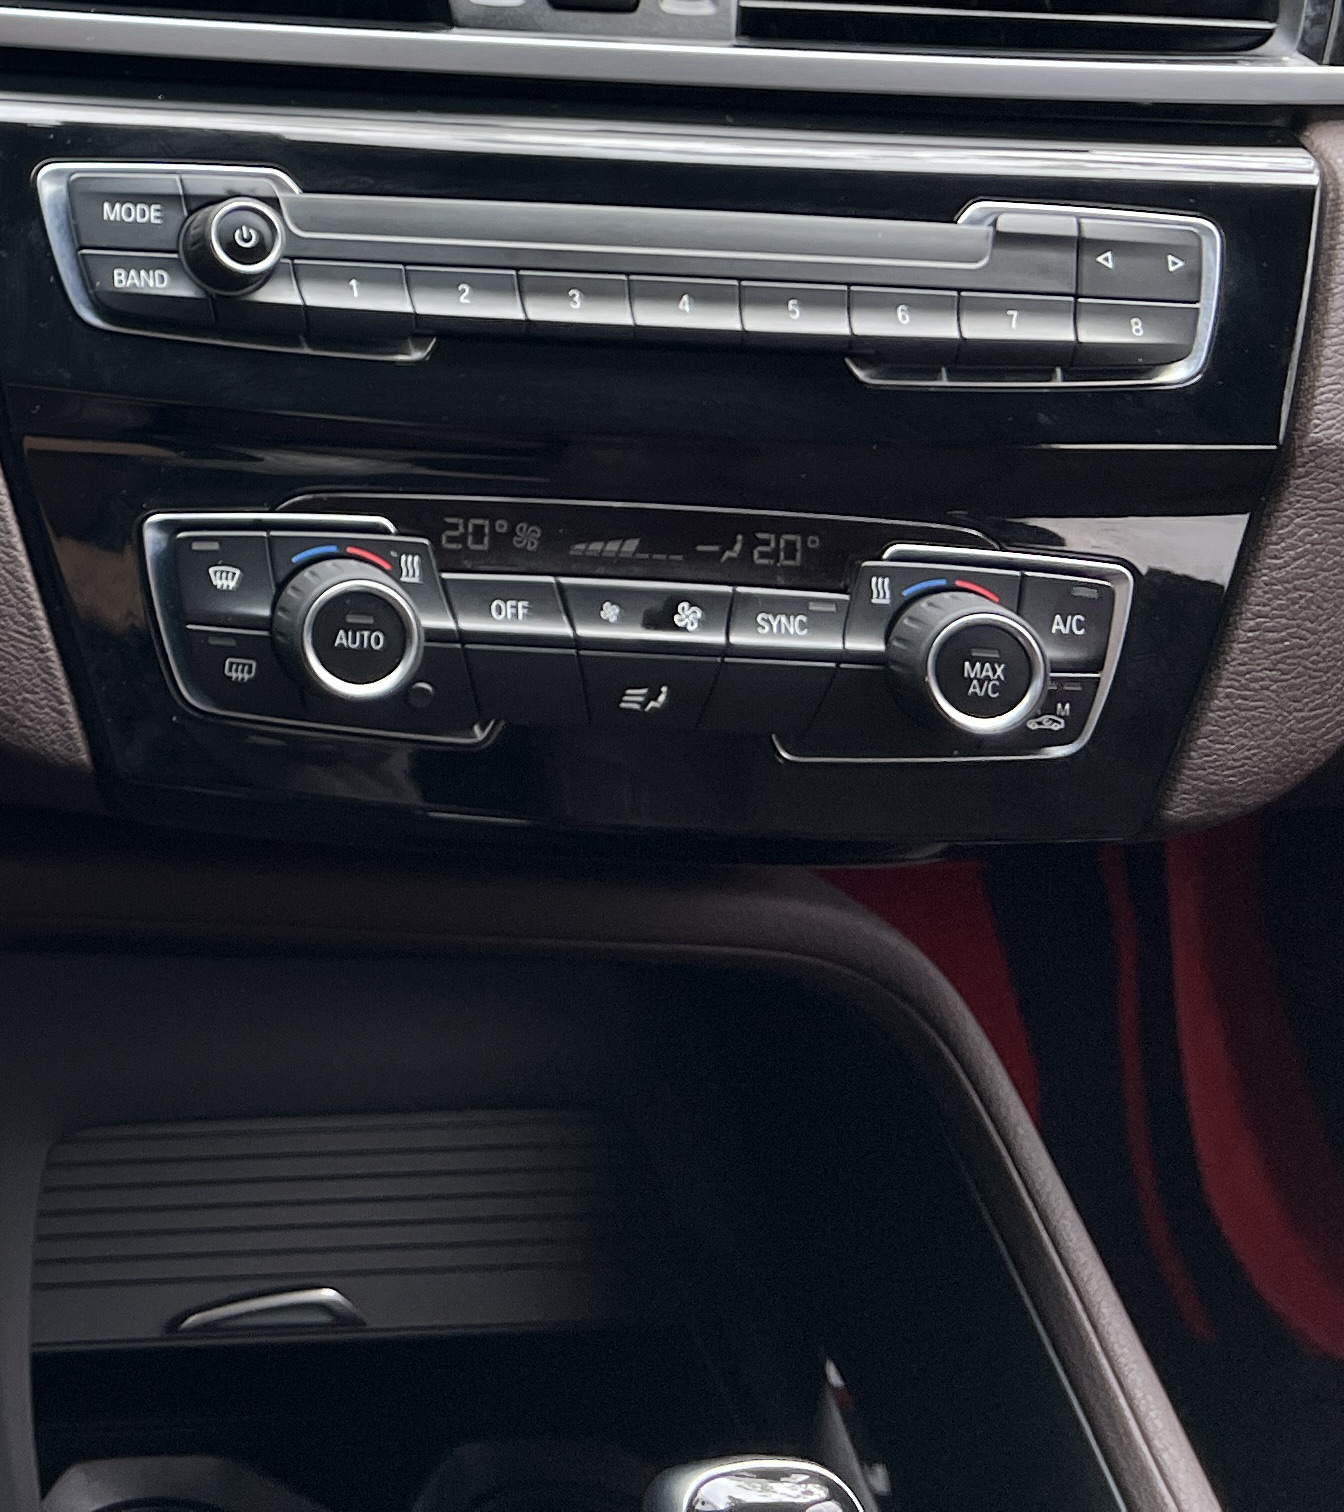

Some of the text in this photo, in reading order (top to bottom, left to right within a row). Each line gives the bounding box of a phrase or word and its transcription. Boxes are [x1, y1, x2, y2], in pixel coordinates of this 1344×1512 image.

[102, 201, 163, 225] MODE
[112, 267, 169, 289] BAND
[347, 277, 360, 299] 1
[456, 282, 471, 304] 2
[566, 288, 583, 310] 3
[677, 292, 692, 313] 4
[785, 297, 801, 320] 5
[895, 304, 911, 326] 6
[1005, 309, 1020, 330] 7
[1129, 316, 1144, 338] 8
[489, 598, 529, 621] OFF
[755, 612, 808, 636] SYNC
[1050, 613, 1086, 636] A/C
[333, 629, 385, 651] AUTO
[963, 660, 1006, 681] MAX
[966, 679, 1001, 699] A/C
